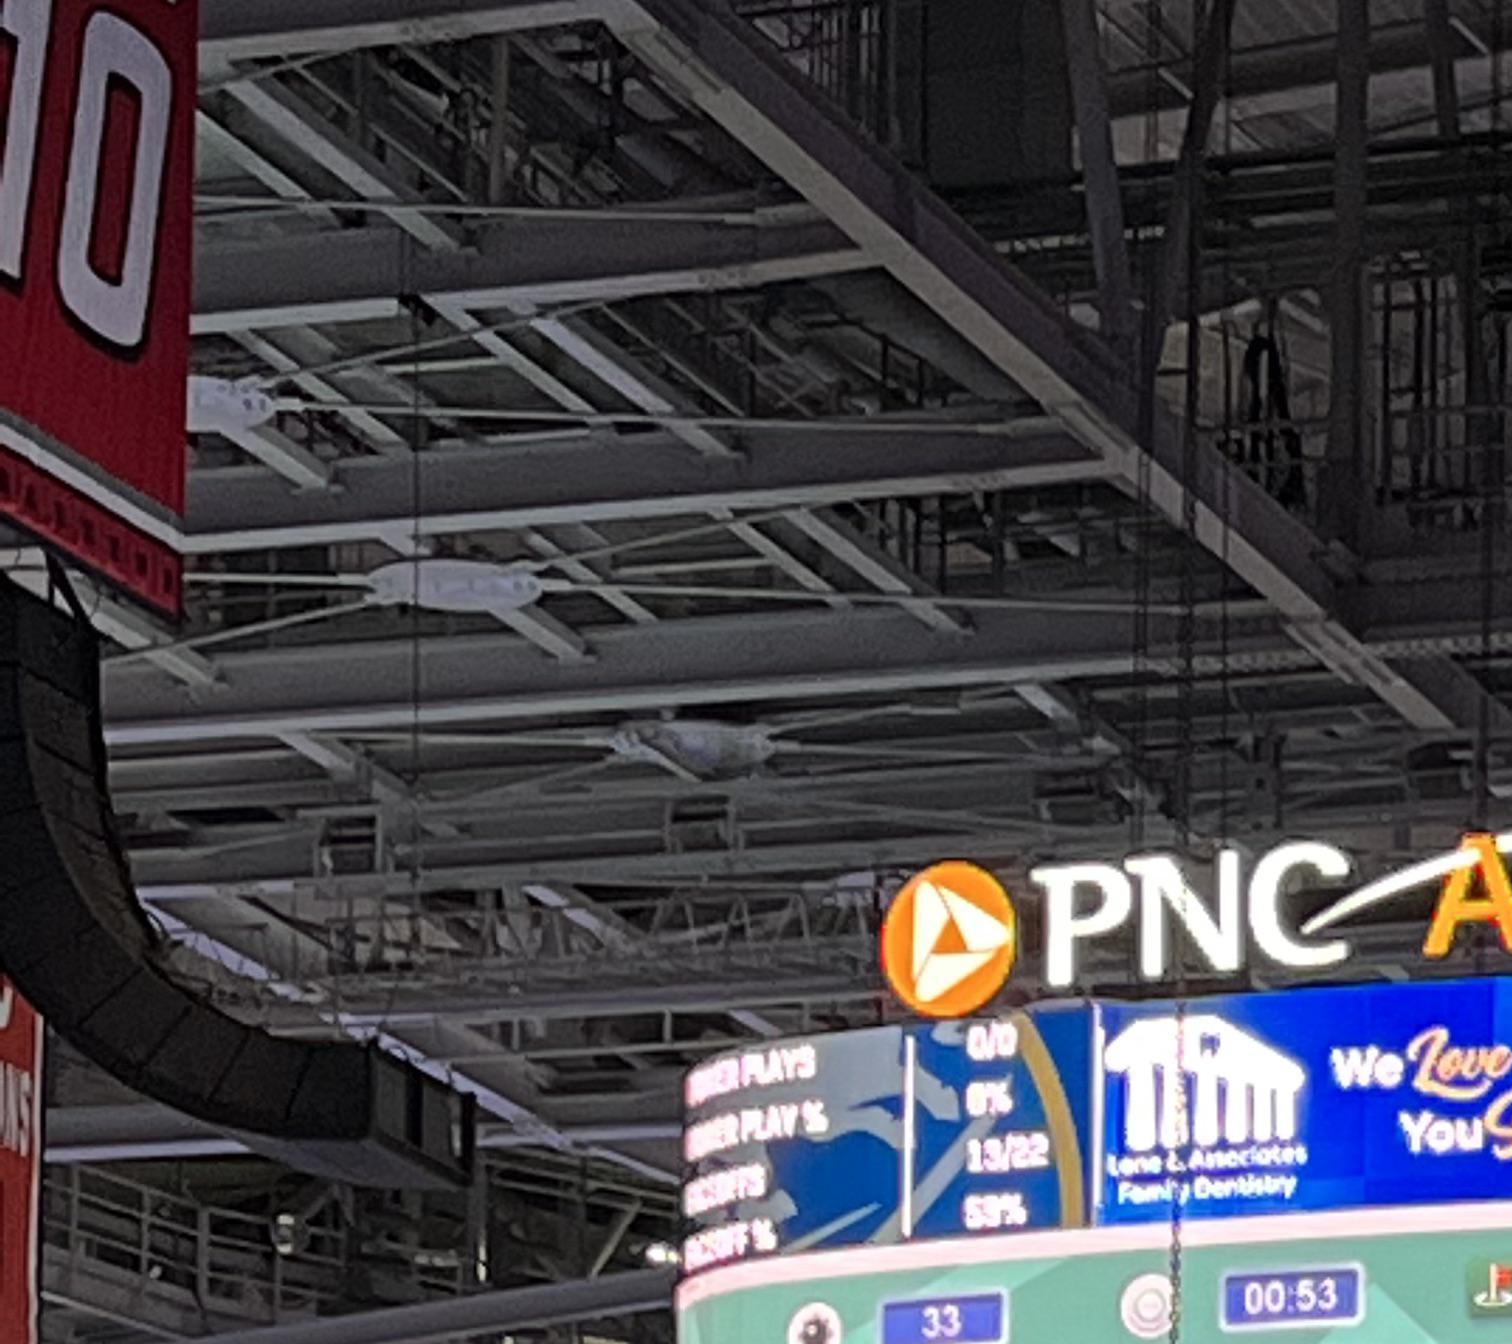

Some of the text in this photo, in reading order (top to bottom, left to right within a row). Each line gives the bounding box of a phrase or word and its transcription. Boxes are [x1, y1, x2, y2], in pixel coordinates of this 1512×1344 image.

[1029, 841, 1351, 986] PNC
[1332, 1045, 1402, 1092] We
[1400, 1111, 1483, 1155] You
[1244, 1276, 1337, 1314] 00:53
[920, 1305, 962, 1339] 33
